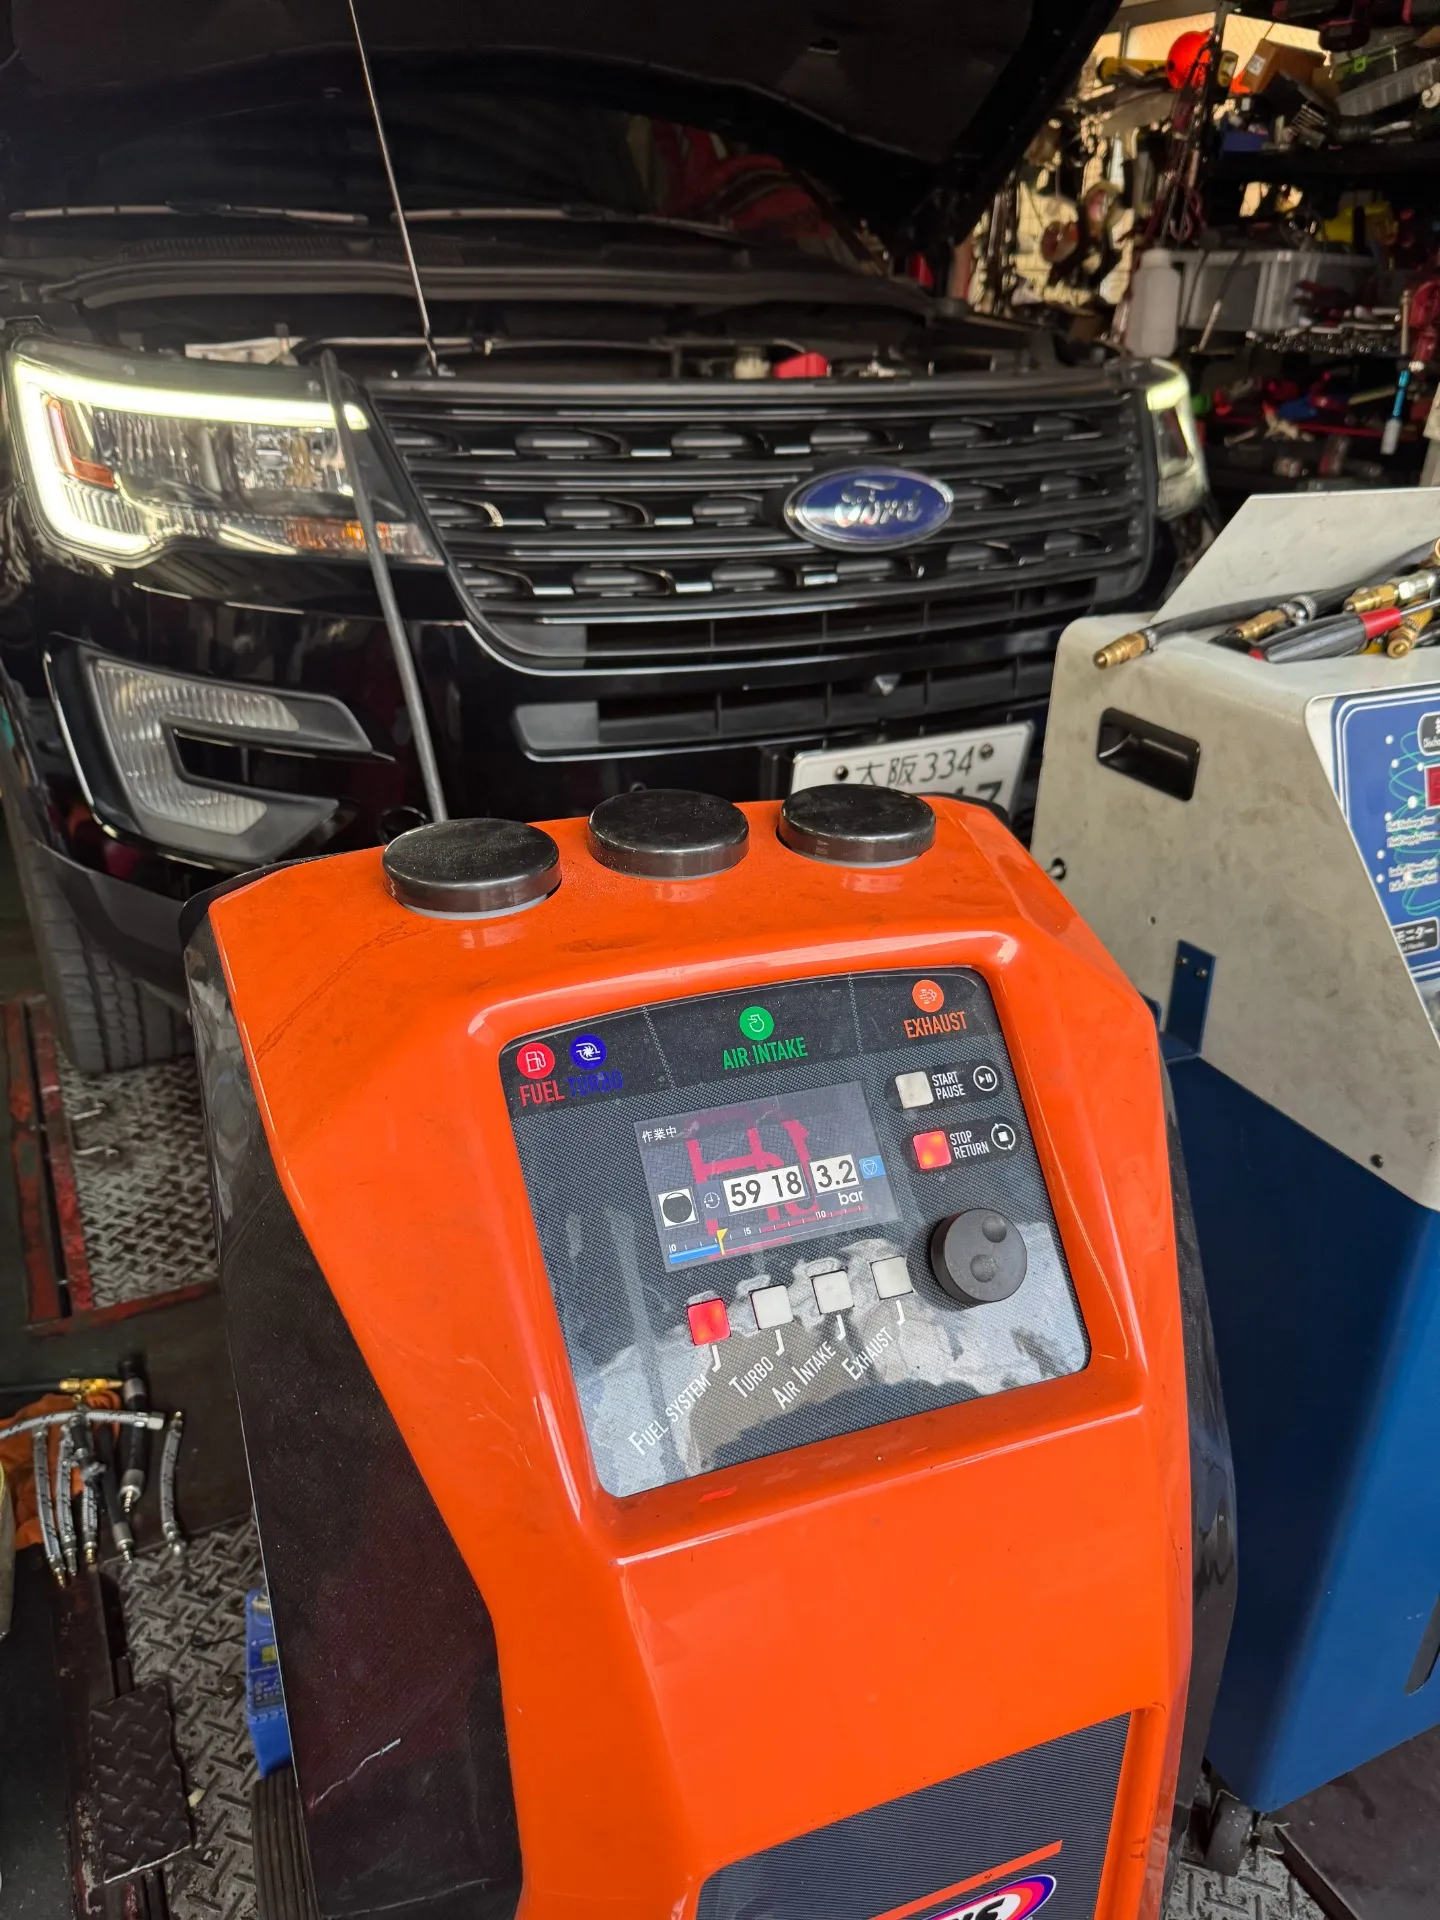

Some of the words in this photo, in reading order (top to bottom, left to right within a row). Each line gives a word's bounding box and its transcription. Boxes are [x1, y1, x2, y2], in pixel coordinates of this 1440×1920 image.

[833, 479, 923, 528] Ford
[903, 1011, 967, 1039] EXHAUST
[722, 1046, 750, 1070] AIR
[752, 1036, 808, 1065] INTAKE
[519, 1079, 565, 1107] FUEL
[567, 1069, 624, 1097] TURBO
[932, 1071, 958, 1087] START
[935, 1083, 965, 1100] PAUSE
[641, 1125, 678, 1144] 作業中
[950, 1130, 972, 1146] STOP
[953, 1141, 990, 1159] RETURN
[816, 1159, 857, 1188] 3.2
[730, 1179, 761, 1207] 59
[771, 1171, 802, 1197] 18
[838, 1189, 864, 1206] bar
[841, 1326, 894, 1381] EXHAUST
[728, 1356, 774, 1399] TURBO
[771, 1379, 801, 1411] AIR
[791, 1341, 837, 1387] INTAKE
[628, 1418, 669, 1456] FUEL
[665, 1373, 712, 1423] SYSTEM
